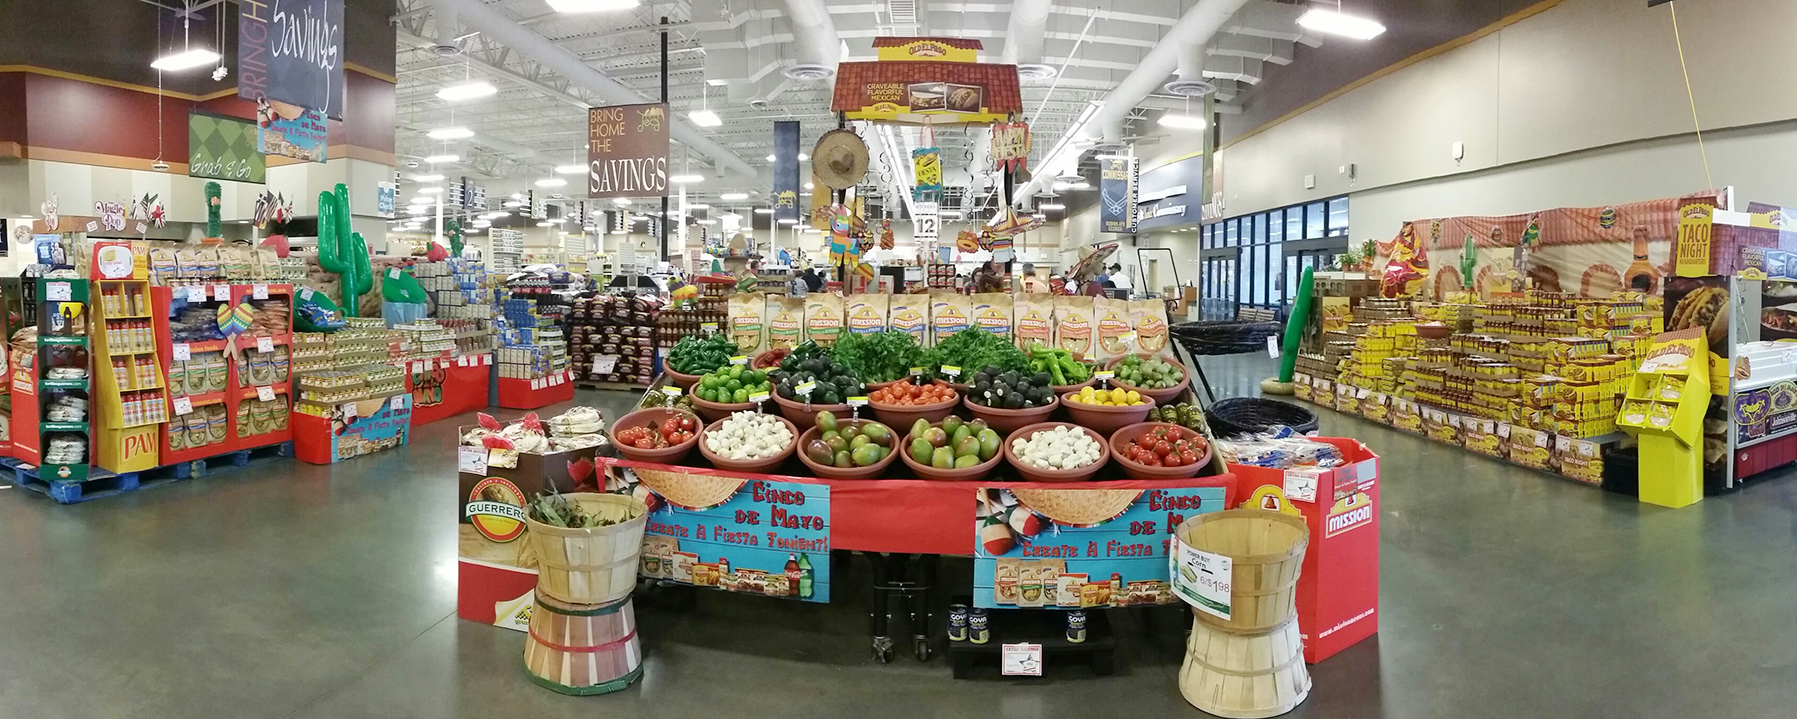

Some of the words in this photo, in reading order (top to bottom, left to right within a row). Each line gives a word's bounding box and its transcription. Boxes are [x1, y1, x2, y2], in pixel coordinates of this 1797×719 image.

[909, 44, 921, 56] OLD
[590, 107, 624, 125] BRING
[590, 122, 626, 138] HOME
[590, 138, 612, 153] THE
[191, 153, 223, 176] Grab
[225, 160, 236, 178] &
[236, 158, 252, 178] Go
[917, 167, 937, 178] FIESTA
[590, 155, 668, 195] SAVINGS
[1102, 169, 1129, 180] COMMISSAR
[915, 218, 937, 233] 12
[1683, 223, 1709, 243] TACO
[1680, 243, 1708, 258] NIGHT
[851, 318, 881, 326] MISSION
[894, 317, 923, 327] MISSION
[935, 317, 966, 325] MISSION
[978, 318, 1007, 326] MISSION
[1646, 347, 1666, 361] OLD
[1665, 344, 1677, 356] EL
[1676, 343, 1696, 359] PASO
[124, 432, 156, 460] PAM
[752, 480, 805, 505] CINCO
[1149, 490, 1201, 511] CINCO
[735, 509, 760, 525] DE
[770, 505, 824, 530] MAYO
[1328, 506, 1370, 532] MISSION
[1130, 520, 1156, 536] DE
[696, 524, 707, 540] A
[714, 525, 758, 546] FIESTA
[767, 531, 828, 552] TONIGHT!
[1022, 542, 1078, 558] CREATE
[1087, 541, 1098, 557] A
[1107, 540, 1153, 557] FIESTA
[1187, 549, 1200, 560] POWER
[1200, 556, 1211, 564] BUY
[1191, 557, 1207, 569] Corn
